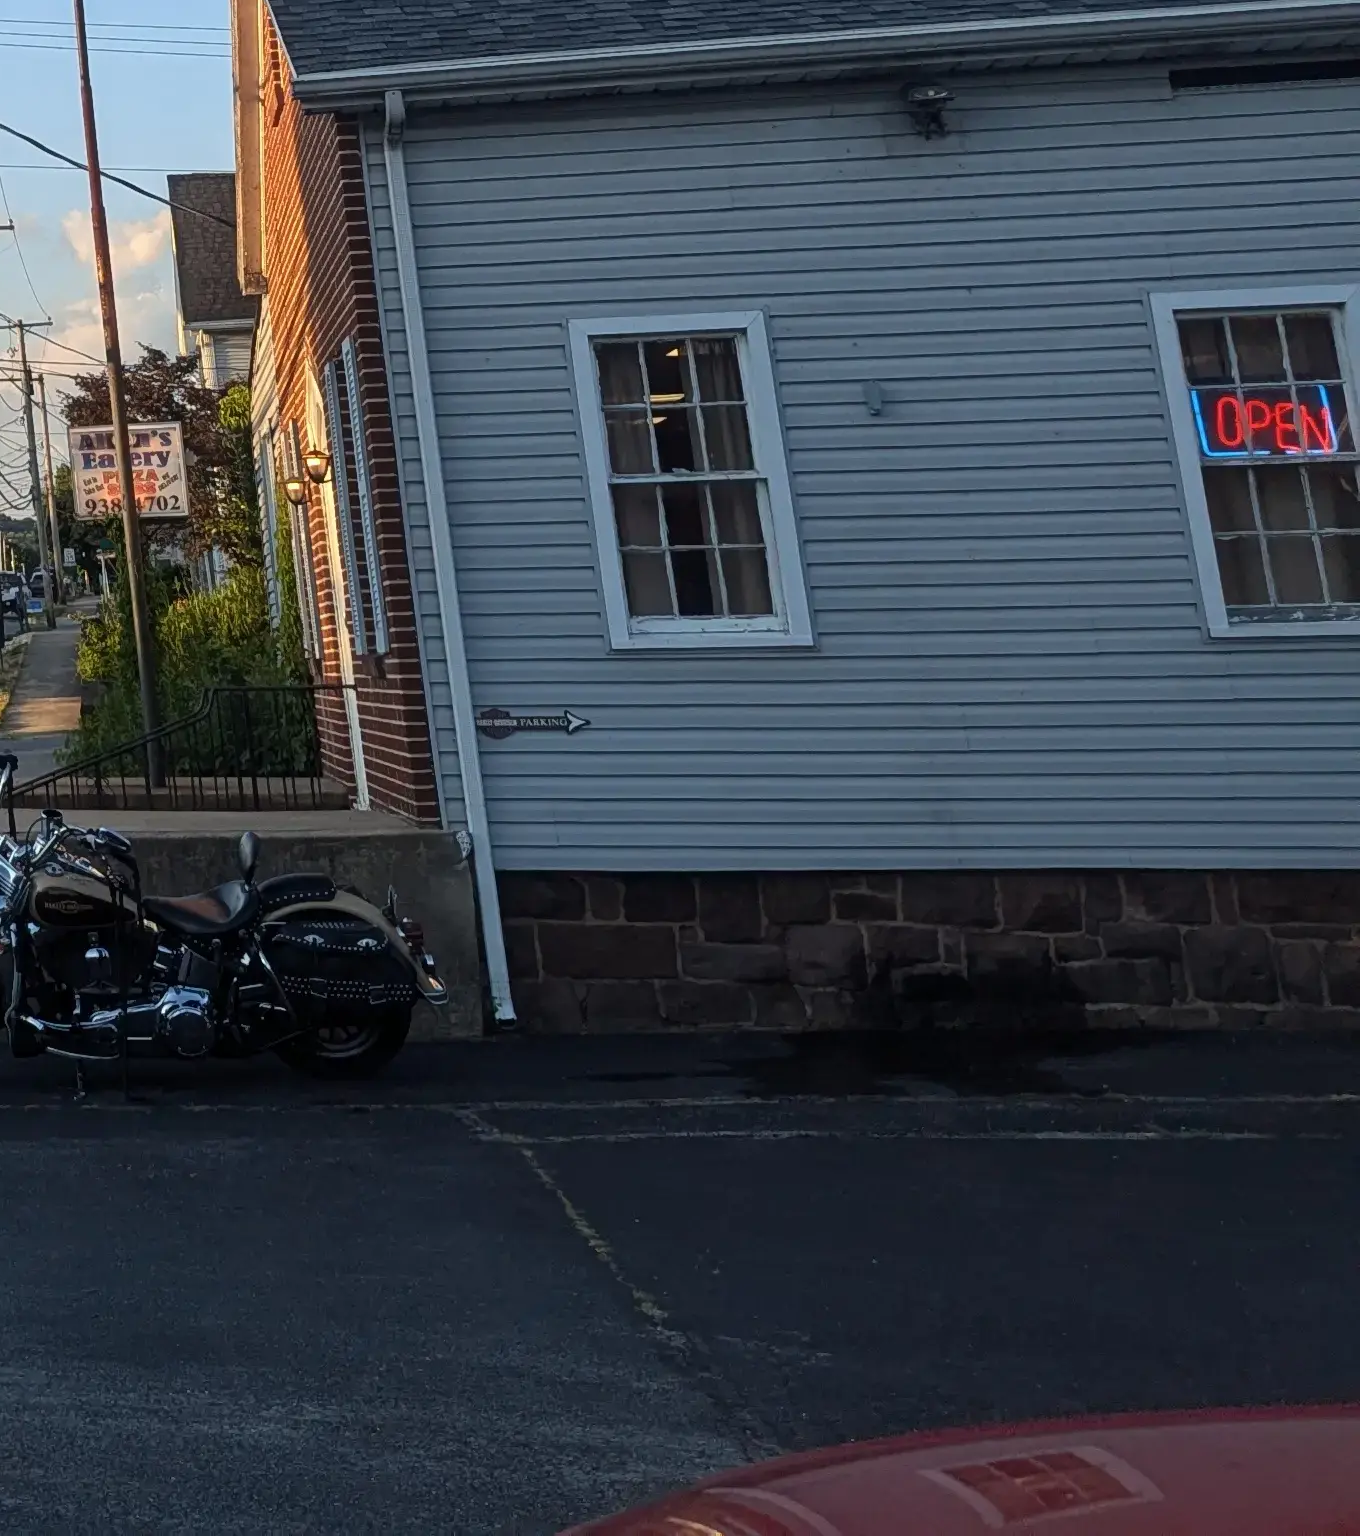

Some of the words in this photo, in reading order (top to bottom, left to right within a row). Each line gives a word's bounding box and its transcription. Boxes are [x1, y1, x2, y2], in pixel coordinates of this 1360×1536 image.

[1215, 395, 1331, 453] OPEN
[81, 450, 172, 469] Eaery
[102, 469, 160, 483] PIZA
[520, 718, 568, 727] PARKING
